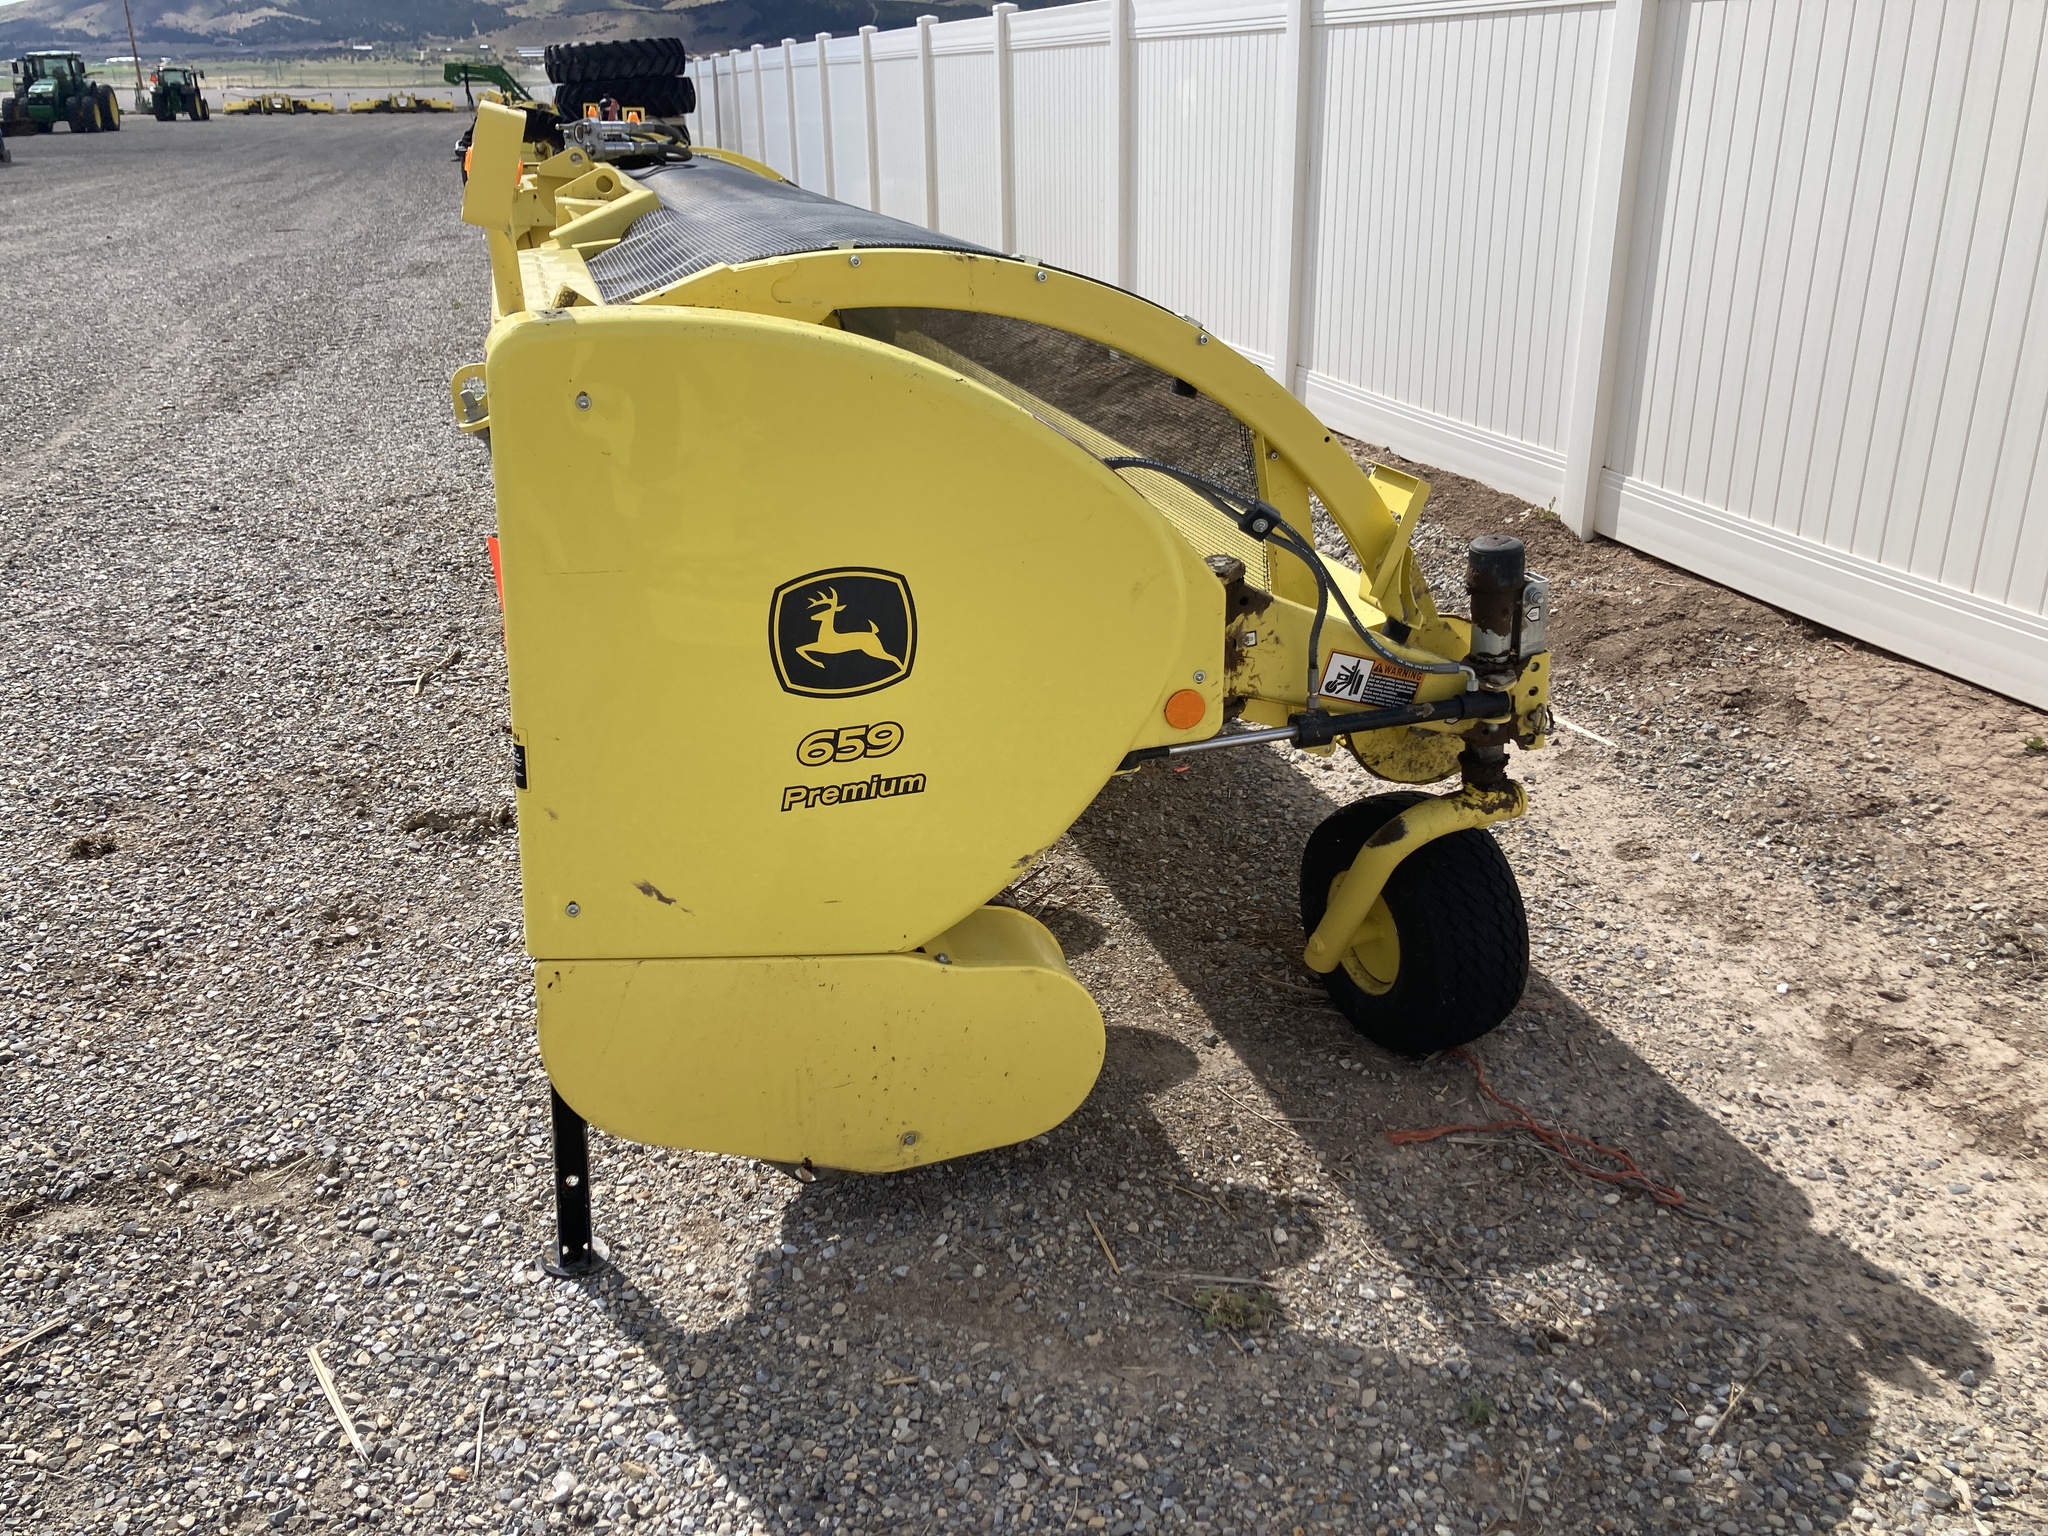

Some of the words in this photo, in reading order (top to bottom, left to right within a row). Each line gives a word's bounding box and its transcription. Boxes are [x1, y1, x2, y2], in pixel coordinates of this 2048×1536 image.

[1384, 664, 1422, 681] WARNING
[796, 721, 904, 767] 659
[781, 772, 927, 812] Premium
